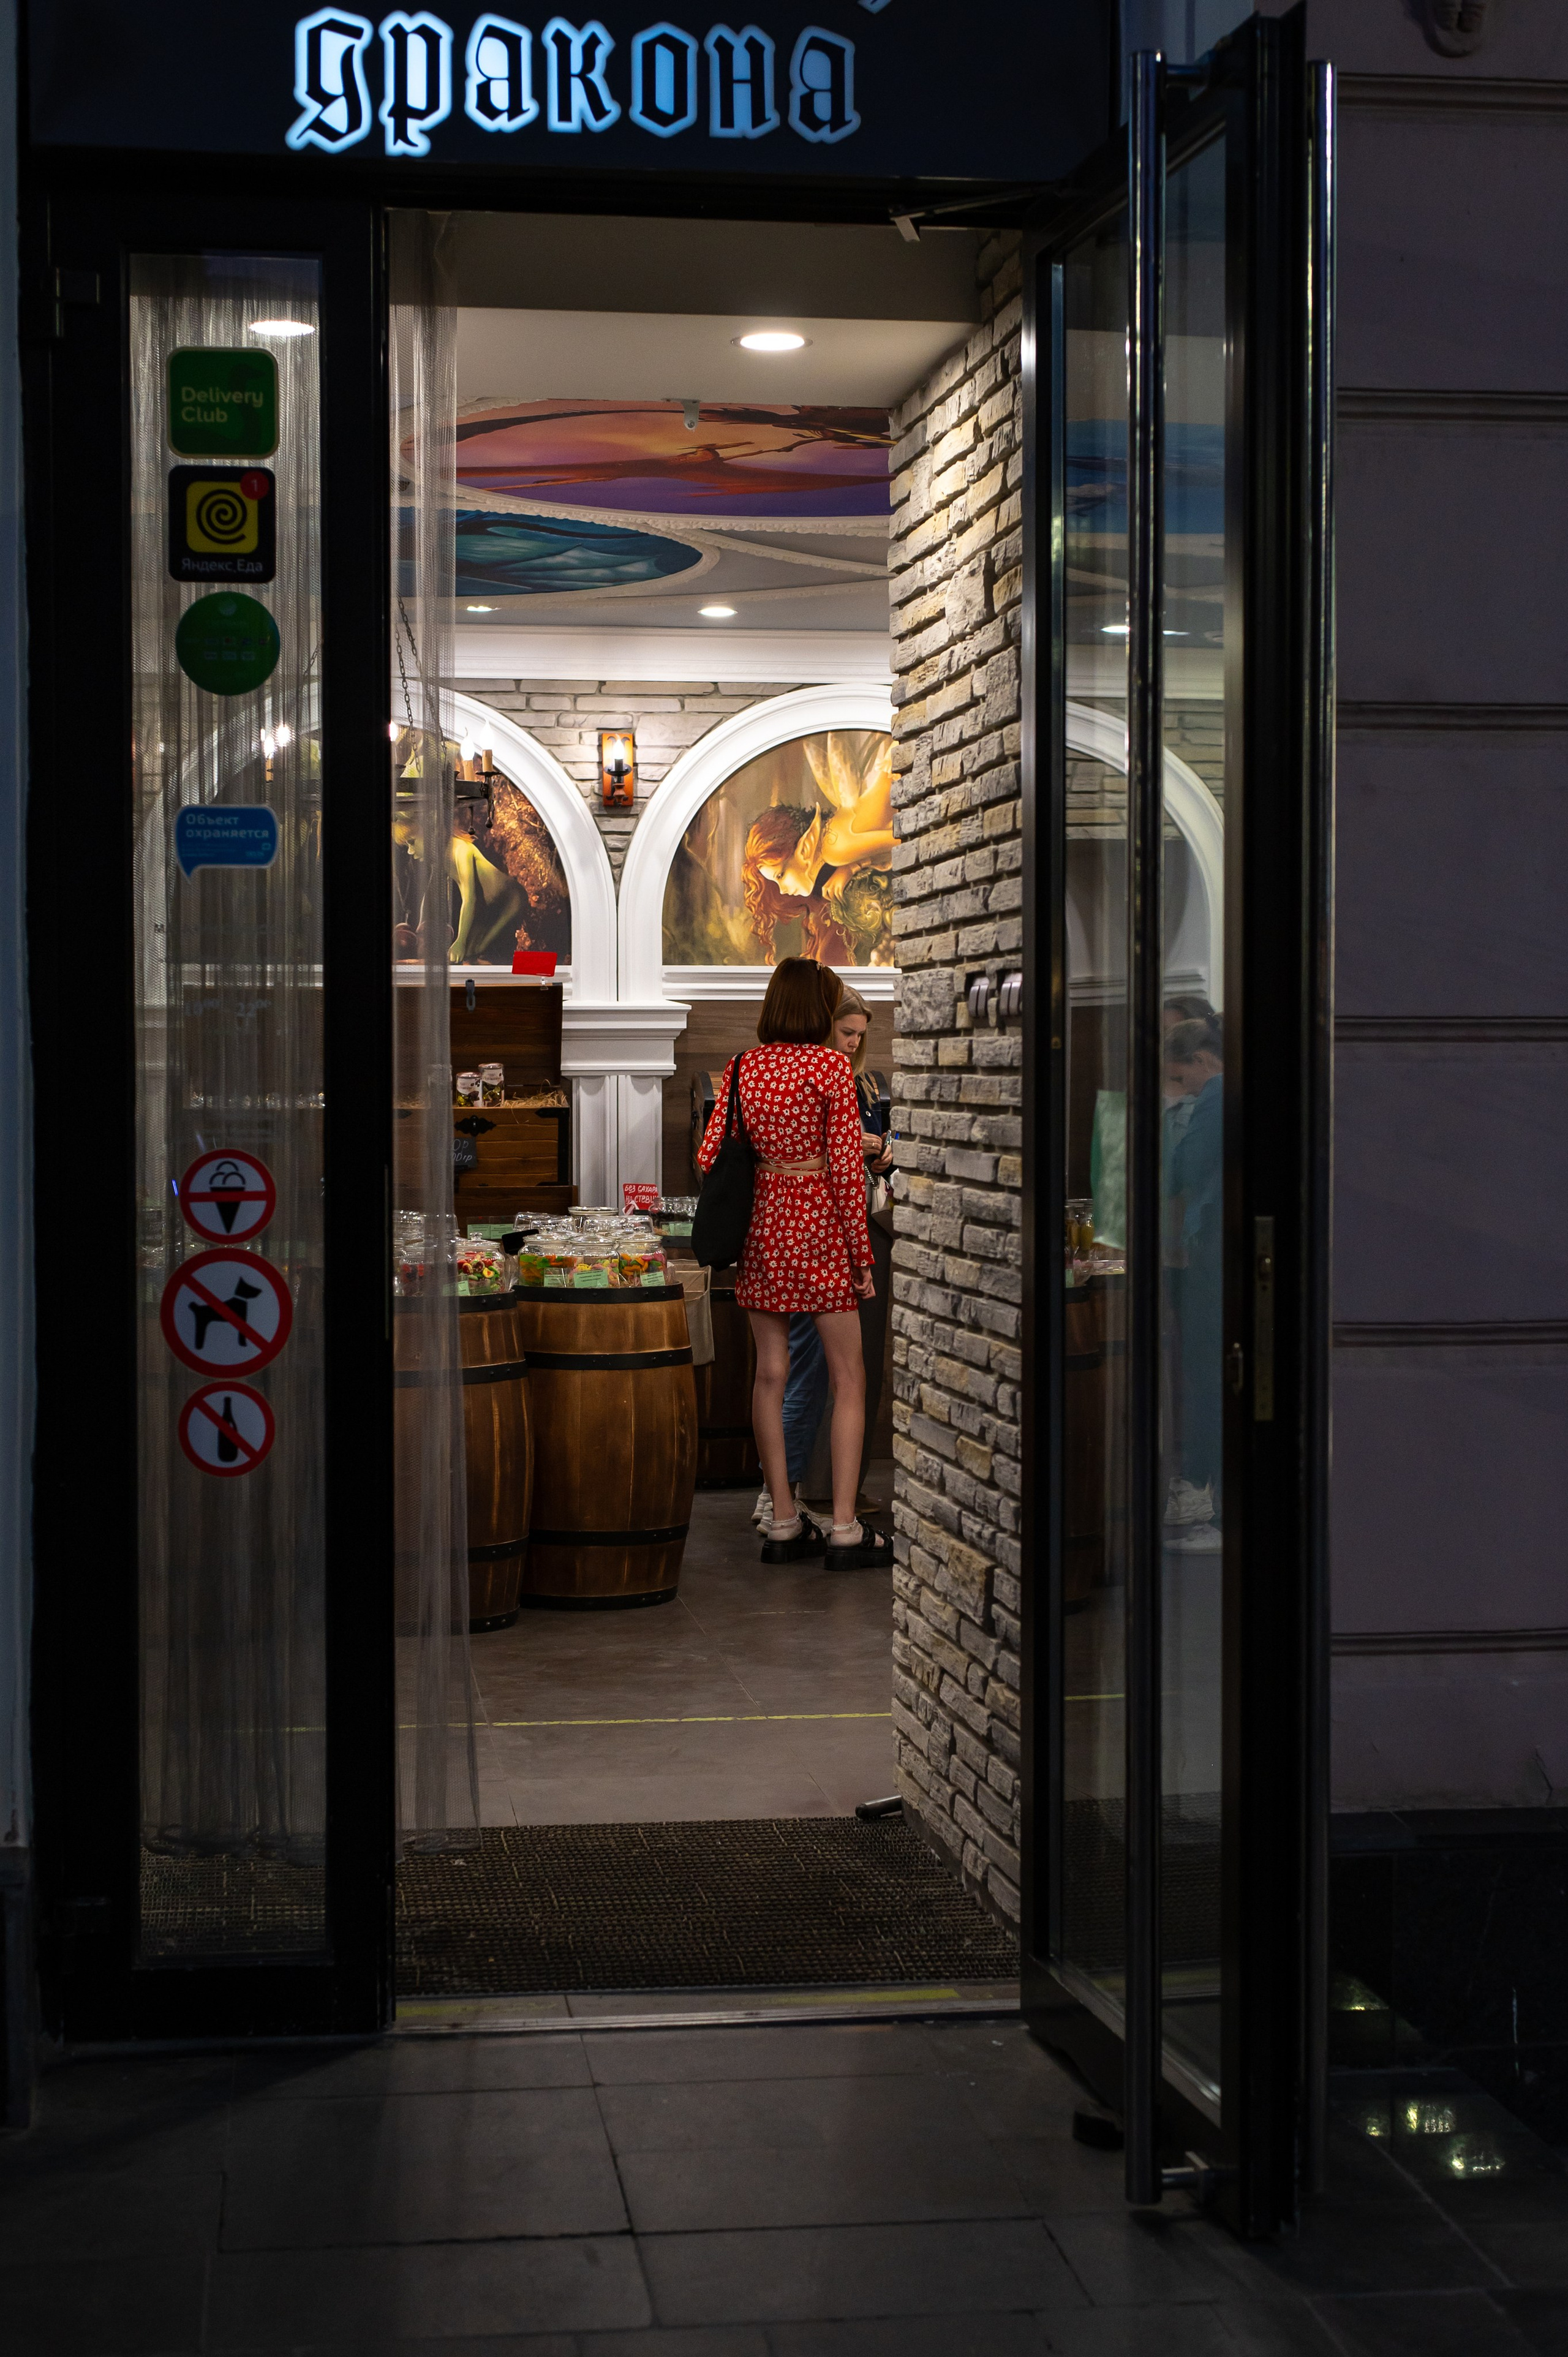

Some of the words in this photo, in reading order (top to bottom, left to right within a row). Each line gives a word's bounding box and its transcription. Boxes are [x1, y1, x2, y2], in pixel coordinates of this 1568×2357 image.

[181, 386, 264, 408] Delivery
[181, 406, 228, 423] Club
[251, 478, 258, 492] 1
[186, 813, 239, 826] Объект
[186, 829, 269, 840] охраняется
